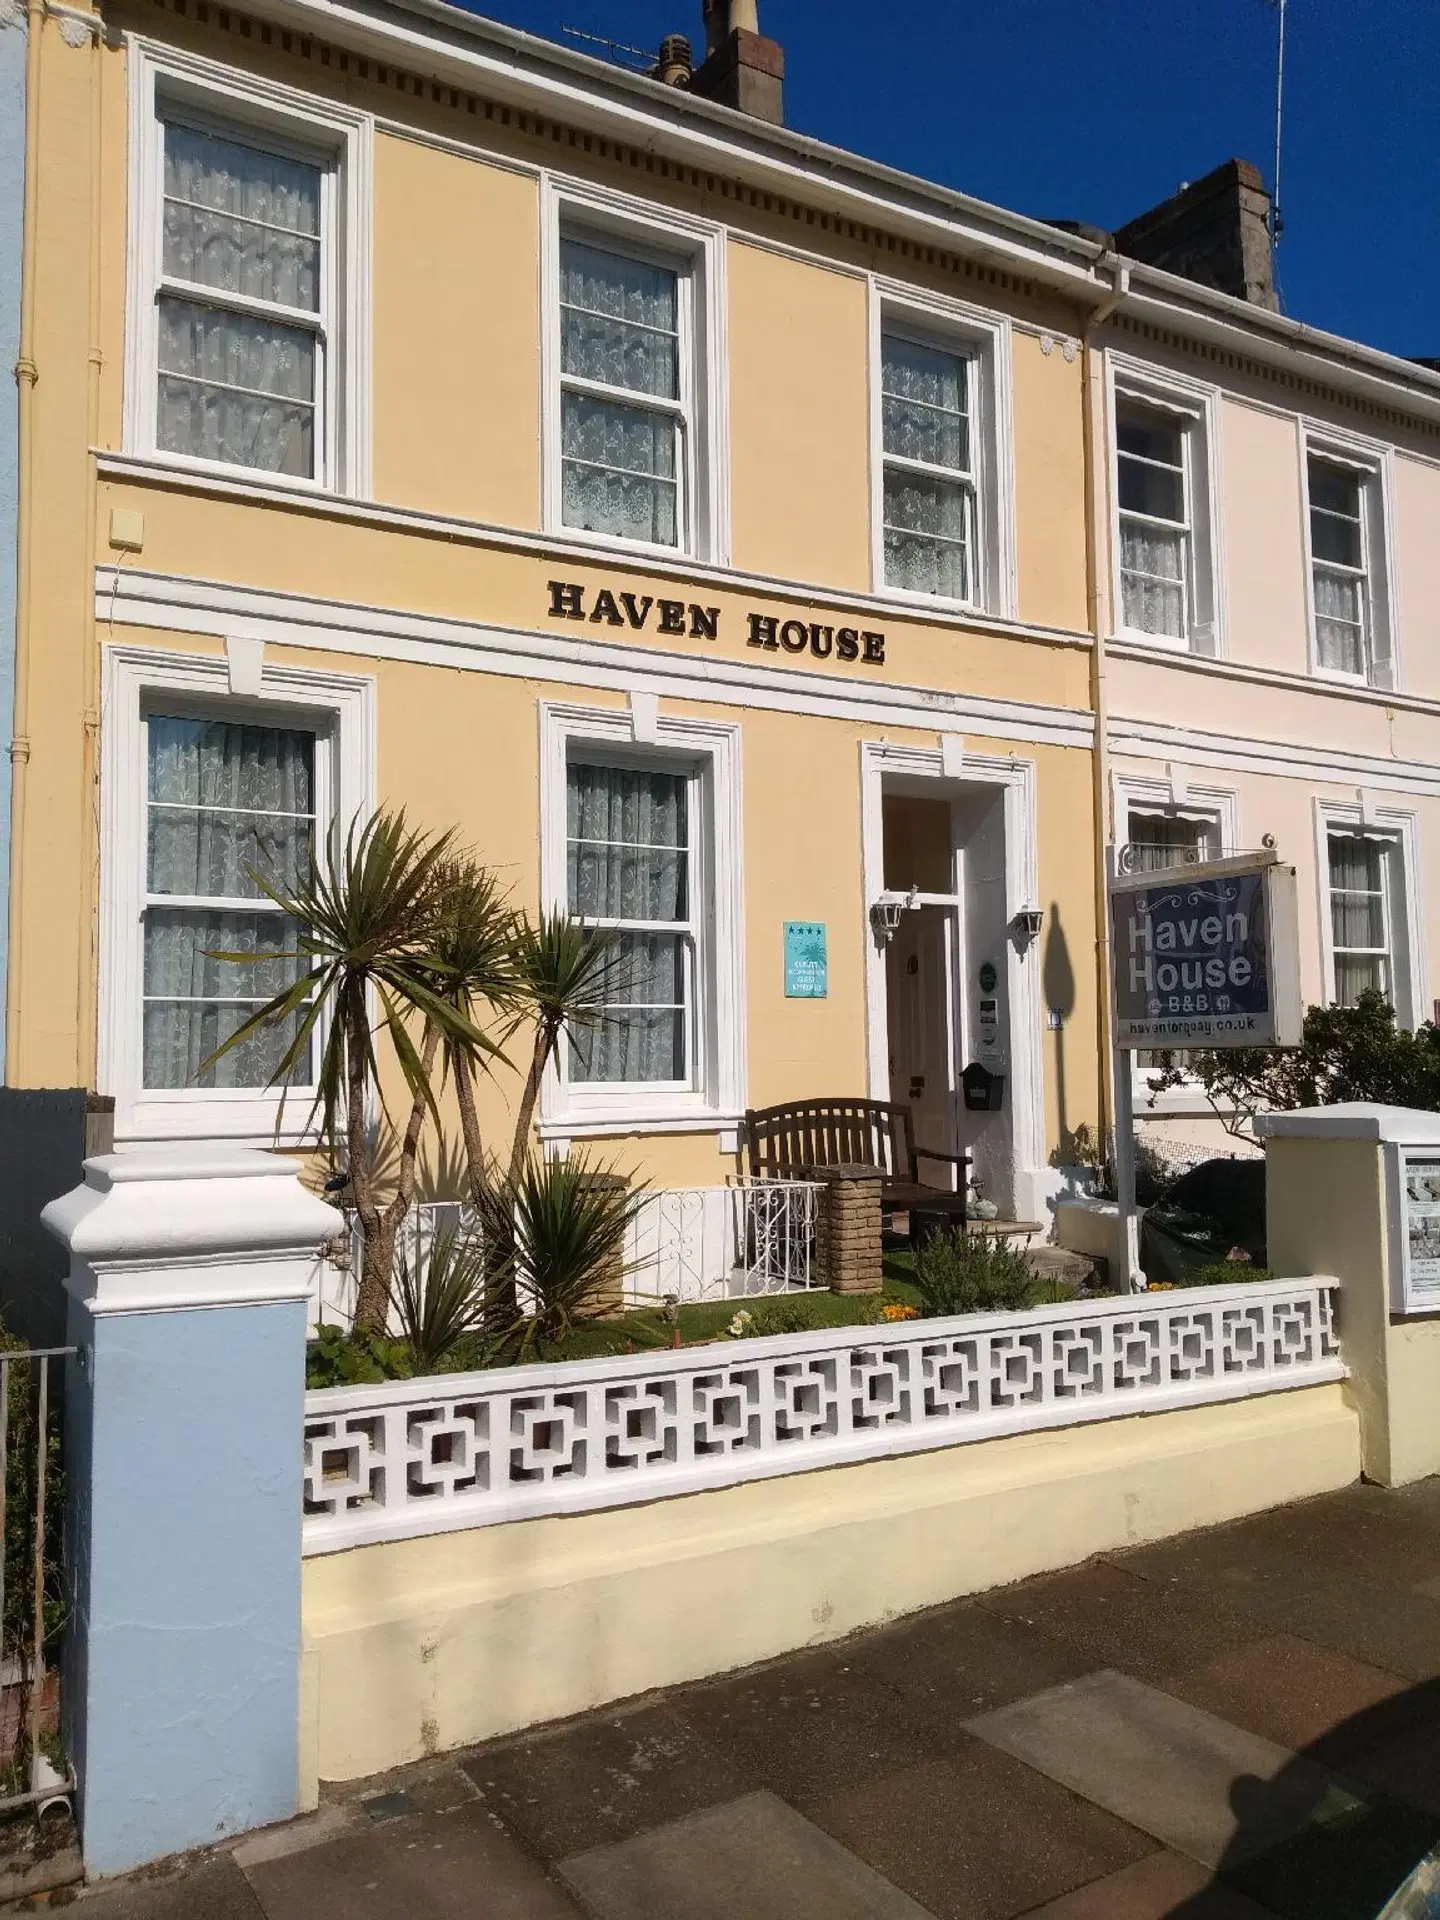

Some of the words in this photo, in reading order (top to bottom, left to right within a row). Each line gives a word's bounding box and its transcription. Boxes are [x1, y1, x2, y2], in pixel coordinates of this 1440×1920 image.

[548, 580, 720, 641] HAVEN
[746, 613, 886, 666] HOUSE
[1128, 912, 1249, 953] Haven
[1129, 956, 1252, 993] House
[1168, 994, 1209, 1013] B&B
[1129, 1016, 1256, 1038] haventorquay.co.uk
